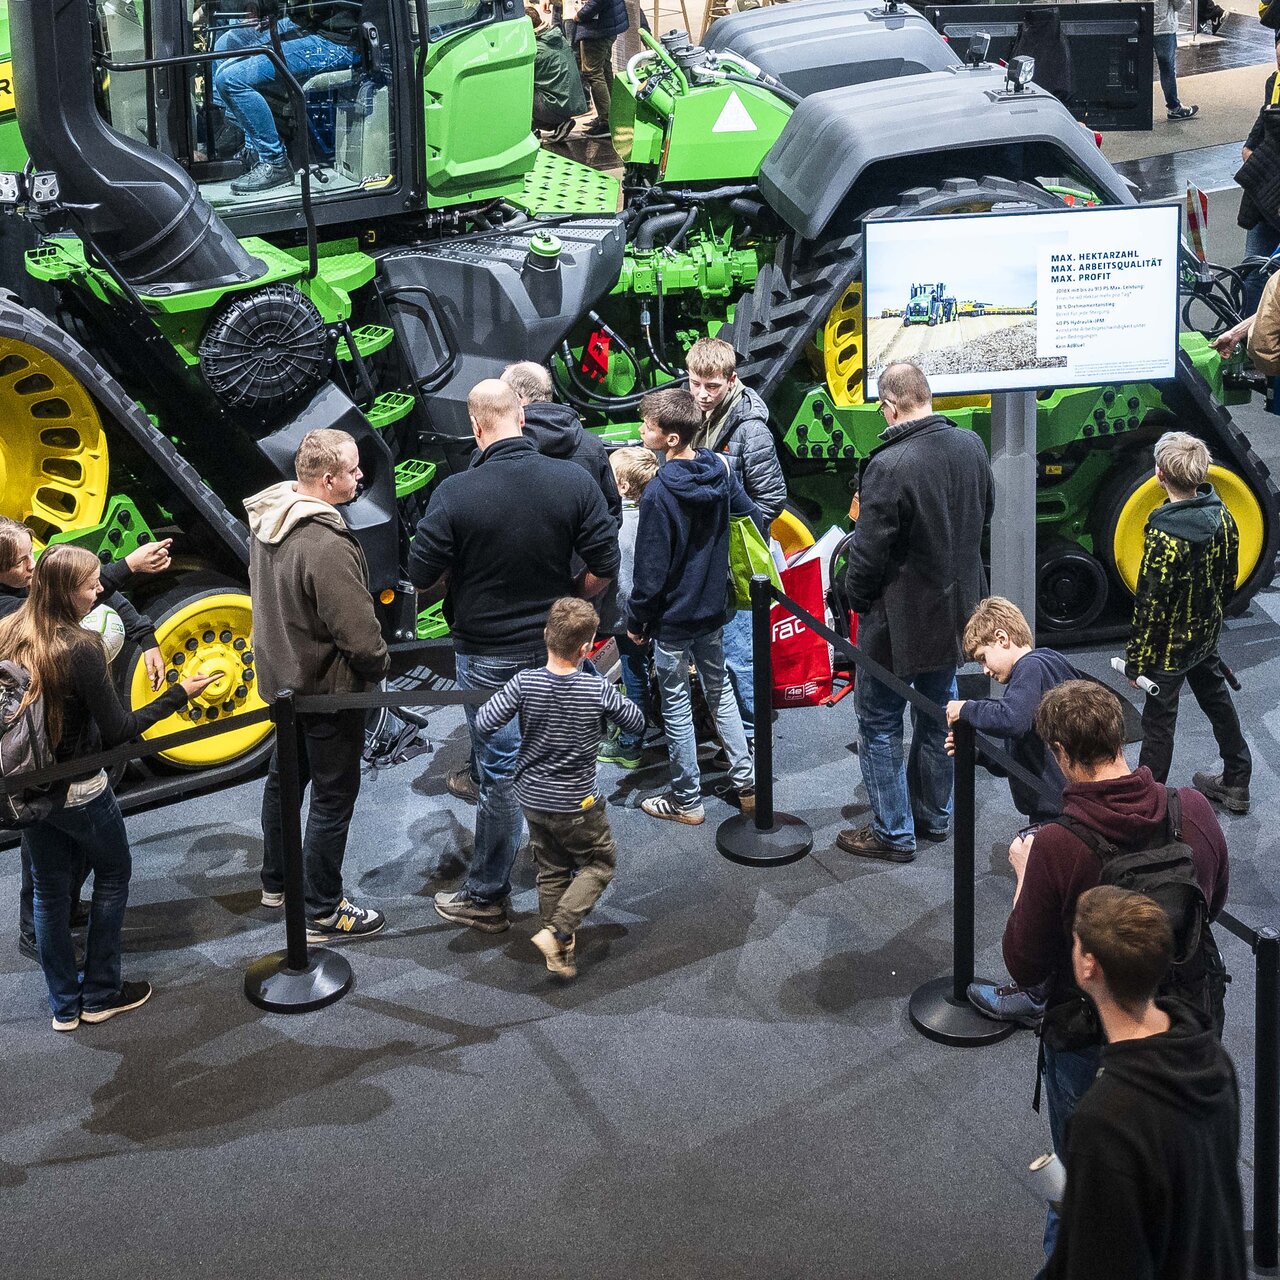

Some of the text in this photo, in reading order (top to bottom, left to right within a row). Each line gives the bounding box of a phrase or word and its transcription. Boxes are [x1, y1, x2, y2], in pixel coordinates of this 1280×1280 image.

[1051, 250, 1139, 262] MAX. HEKTARZAHL
[1051, 258, 1162, 272] MAX. ARBEITSQUALITÄT
[1079, 273, 1111, 281] PROFIT
